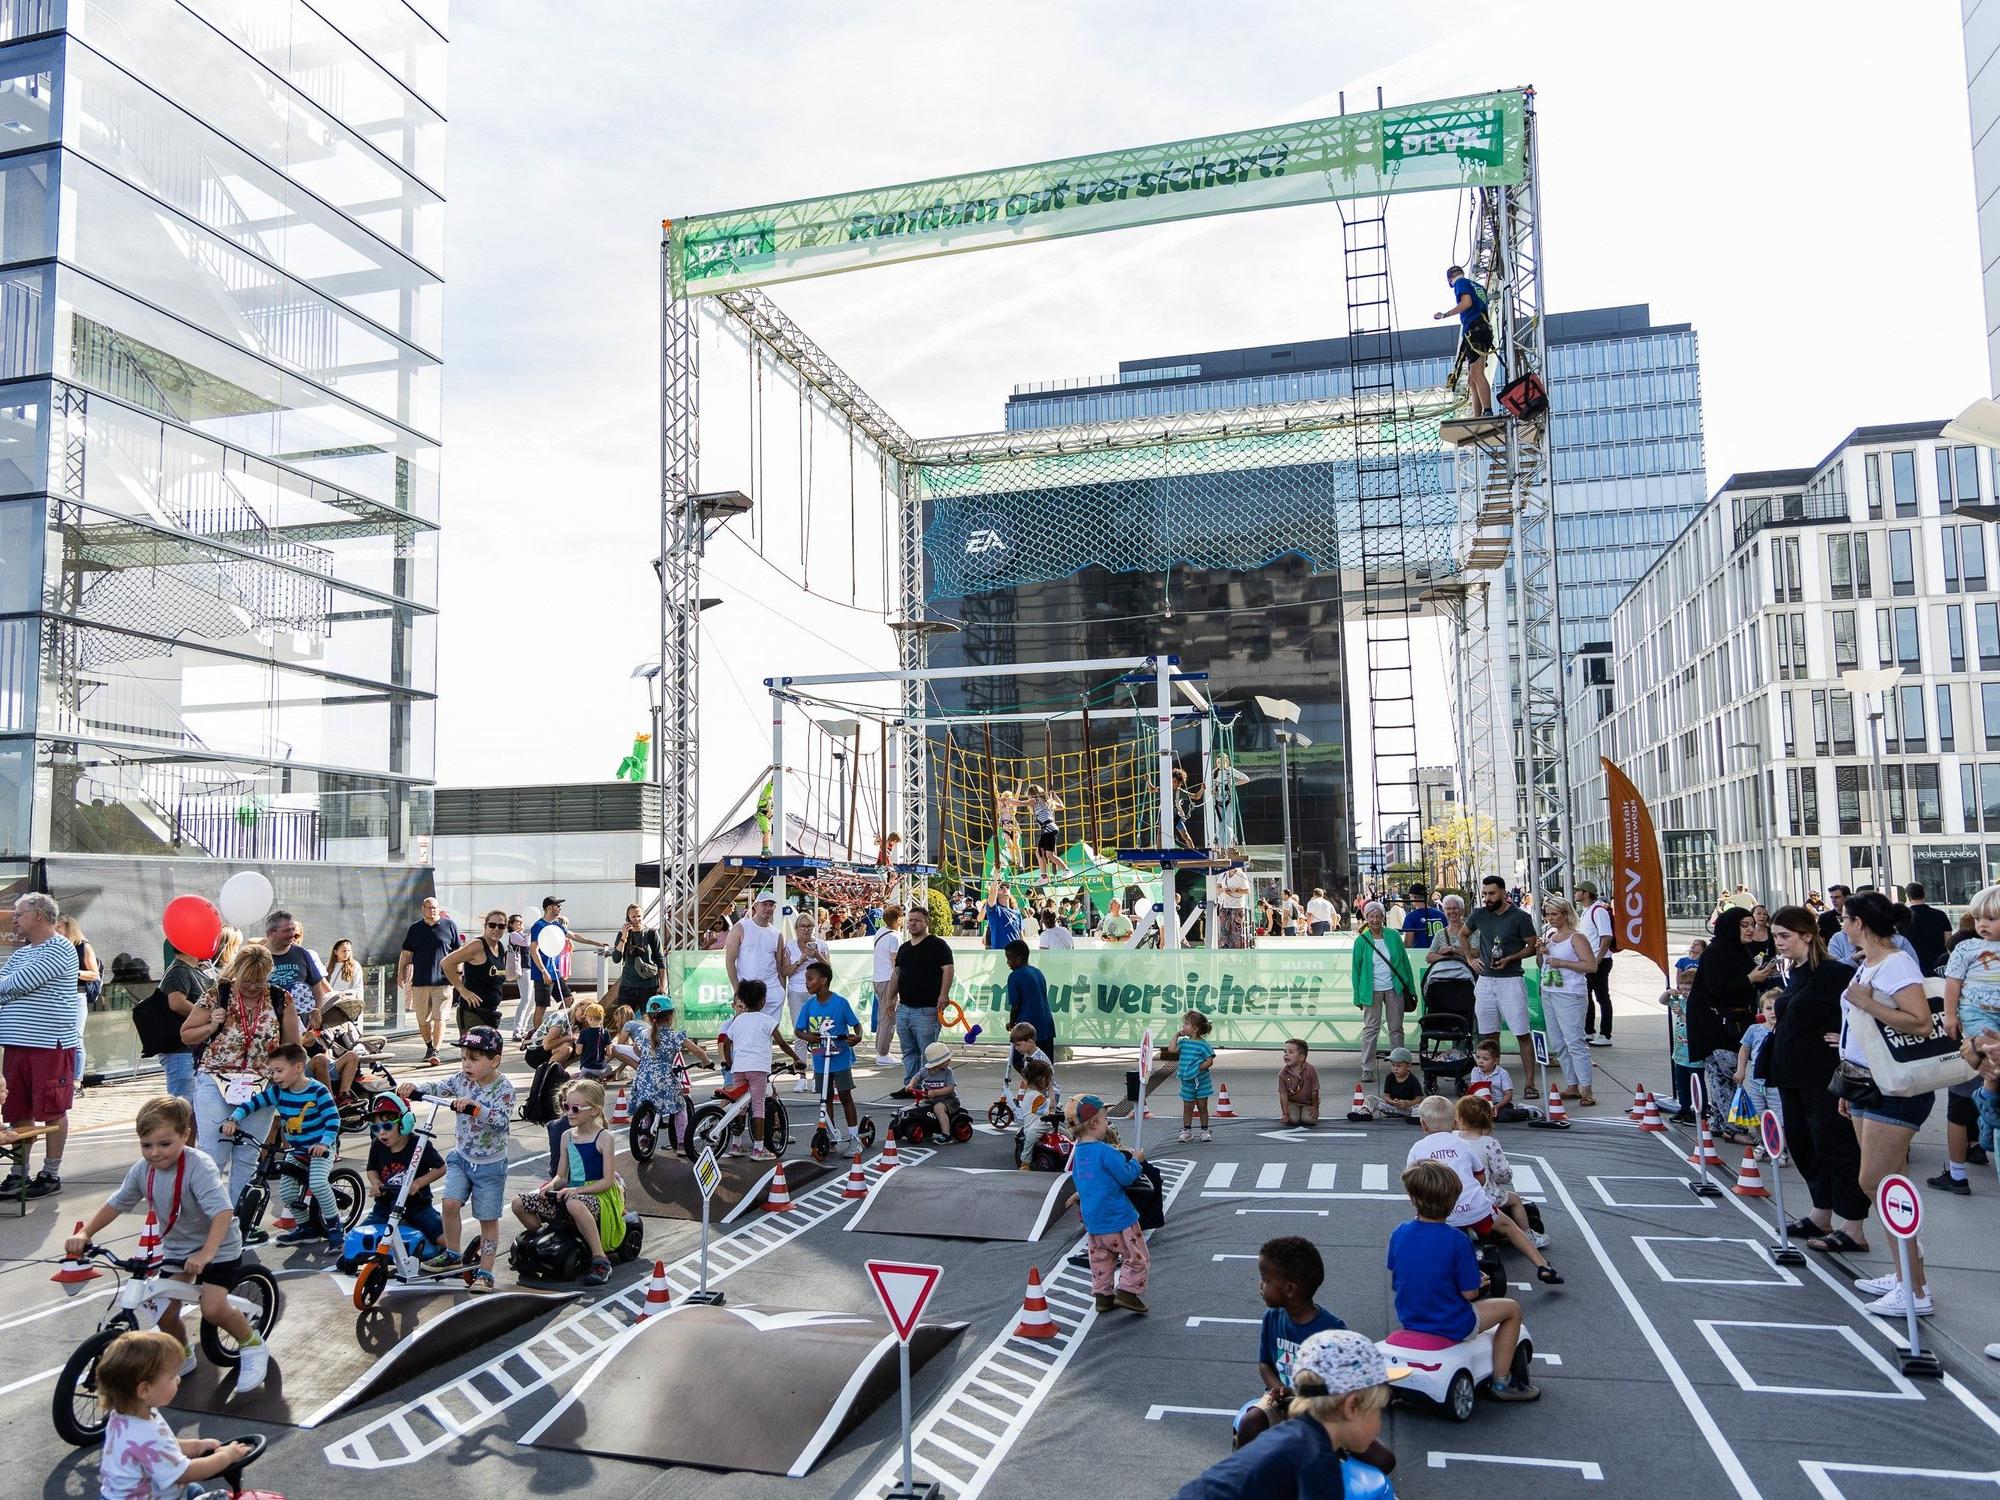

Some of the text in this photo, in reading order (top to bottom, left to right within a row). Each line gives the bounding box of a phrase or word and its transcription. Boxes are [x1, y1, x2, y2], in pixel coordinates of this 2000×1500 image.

[1401, 127, 1485, 155] DEVK
[849, 143, 1290, 242] Rundum gut versichert!
[698, 238, 762, 264] DEVK
[966, 530, 1006, 553] EA
[1622, 801, 1632, 858] Klimafair
[1630, 799, 1640, 863] unterwegs
[1917, 851, 1979, 859] PORCELANOSA
[698, 984, 731, 1003] DE
[1047, 975, 1091, 1013] ut
[1098, 972, 1323, 1016] versichert!
[1888, 1026, 1948, 1049] WEG BA
